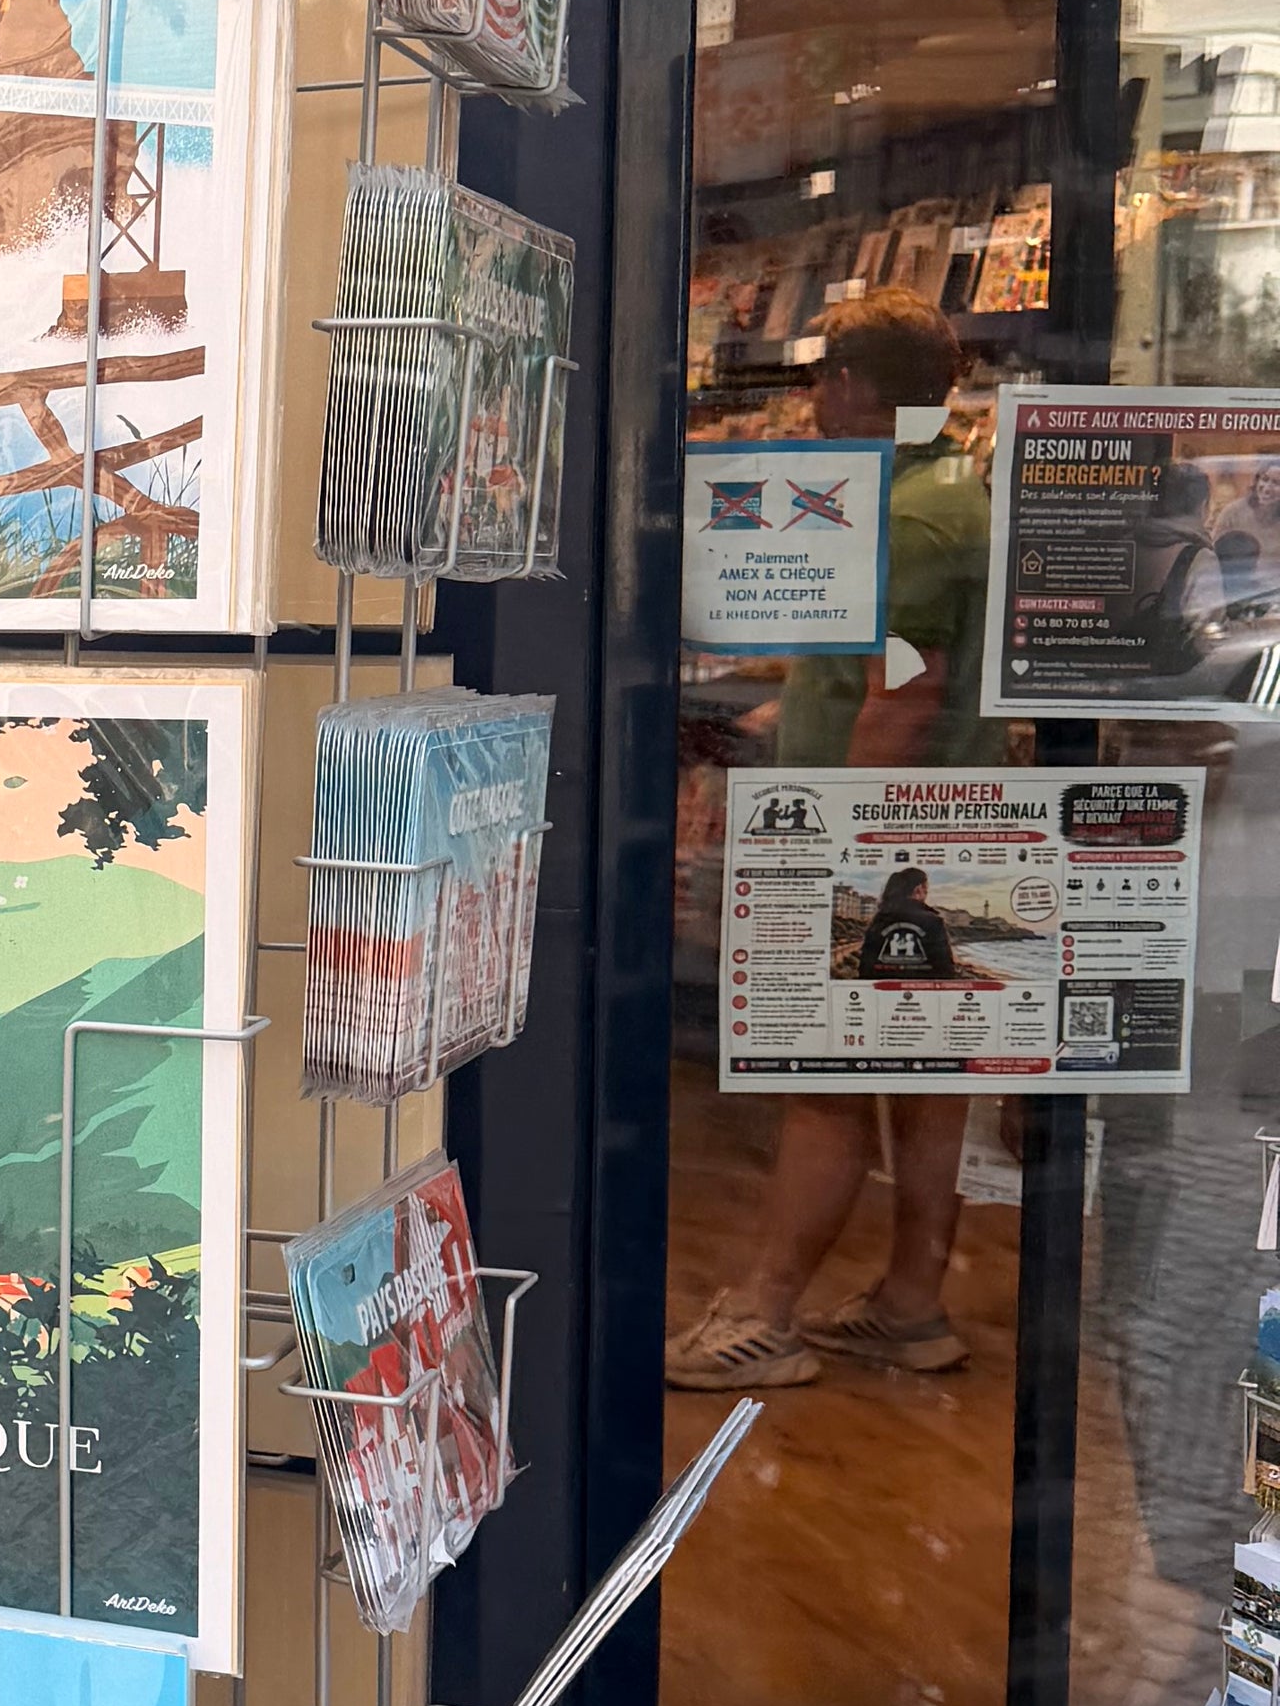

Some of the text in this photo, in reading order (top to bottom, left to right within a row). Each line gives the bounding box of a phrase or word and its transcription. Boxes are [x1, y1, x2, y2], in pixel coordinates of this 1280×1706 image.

[1048, 411, 1088, 429] SUITE
[1091, 411, 1120, 429] AUX
[1123, 411, 1195, 430] INCENDIES
[1198, 413, 1216, 430] EN
[1024, 438, 1132, 461] BESOIN D'UN
[1151, 465, 1162, 487] ?
[1020, 489, 1038, 500] Des
[745, 552, 809, 565] Paiement
[101, 563, 176, 580] ArtDeko
[718, 568, 759, 581] AMEX
[764, 567, 775, 580] &
[726, 586, 827, 602] NON ACCEPTÉ
[709, 610, 722, 620] LE
[791, 609, 848, 620] BIARRITZ
[884, 783, 1003, 803] EMAKUMEEN
[1091, 785, 1123, 798] PARCE
[1145, 785, 1159, 797] LA
[852, 802, 1048, 821] SEGURTASUN PERTSONALA
[356, 1282, 398, 1347] PAYS
[102, 1592, 178, 1616] ArtDeko
